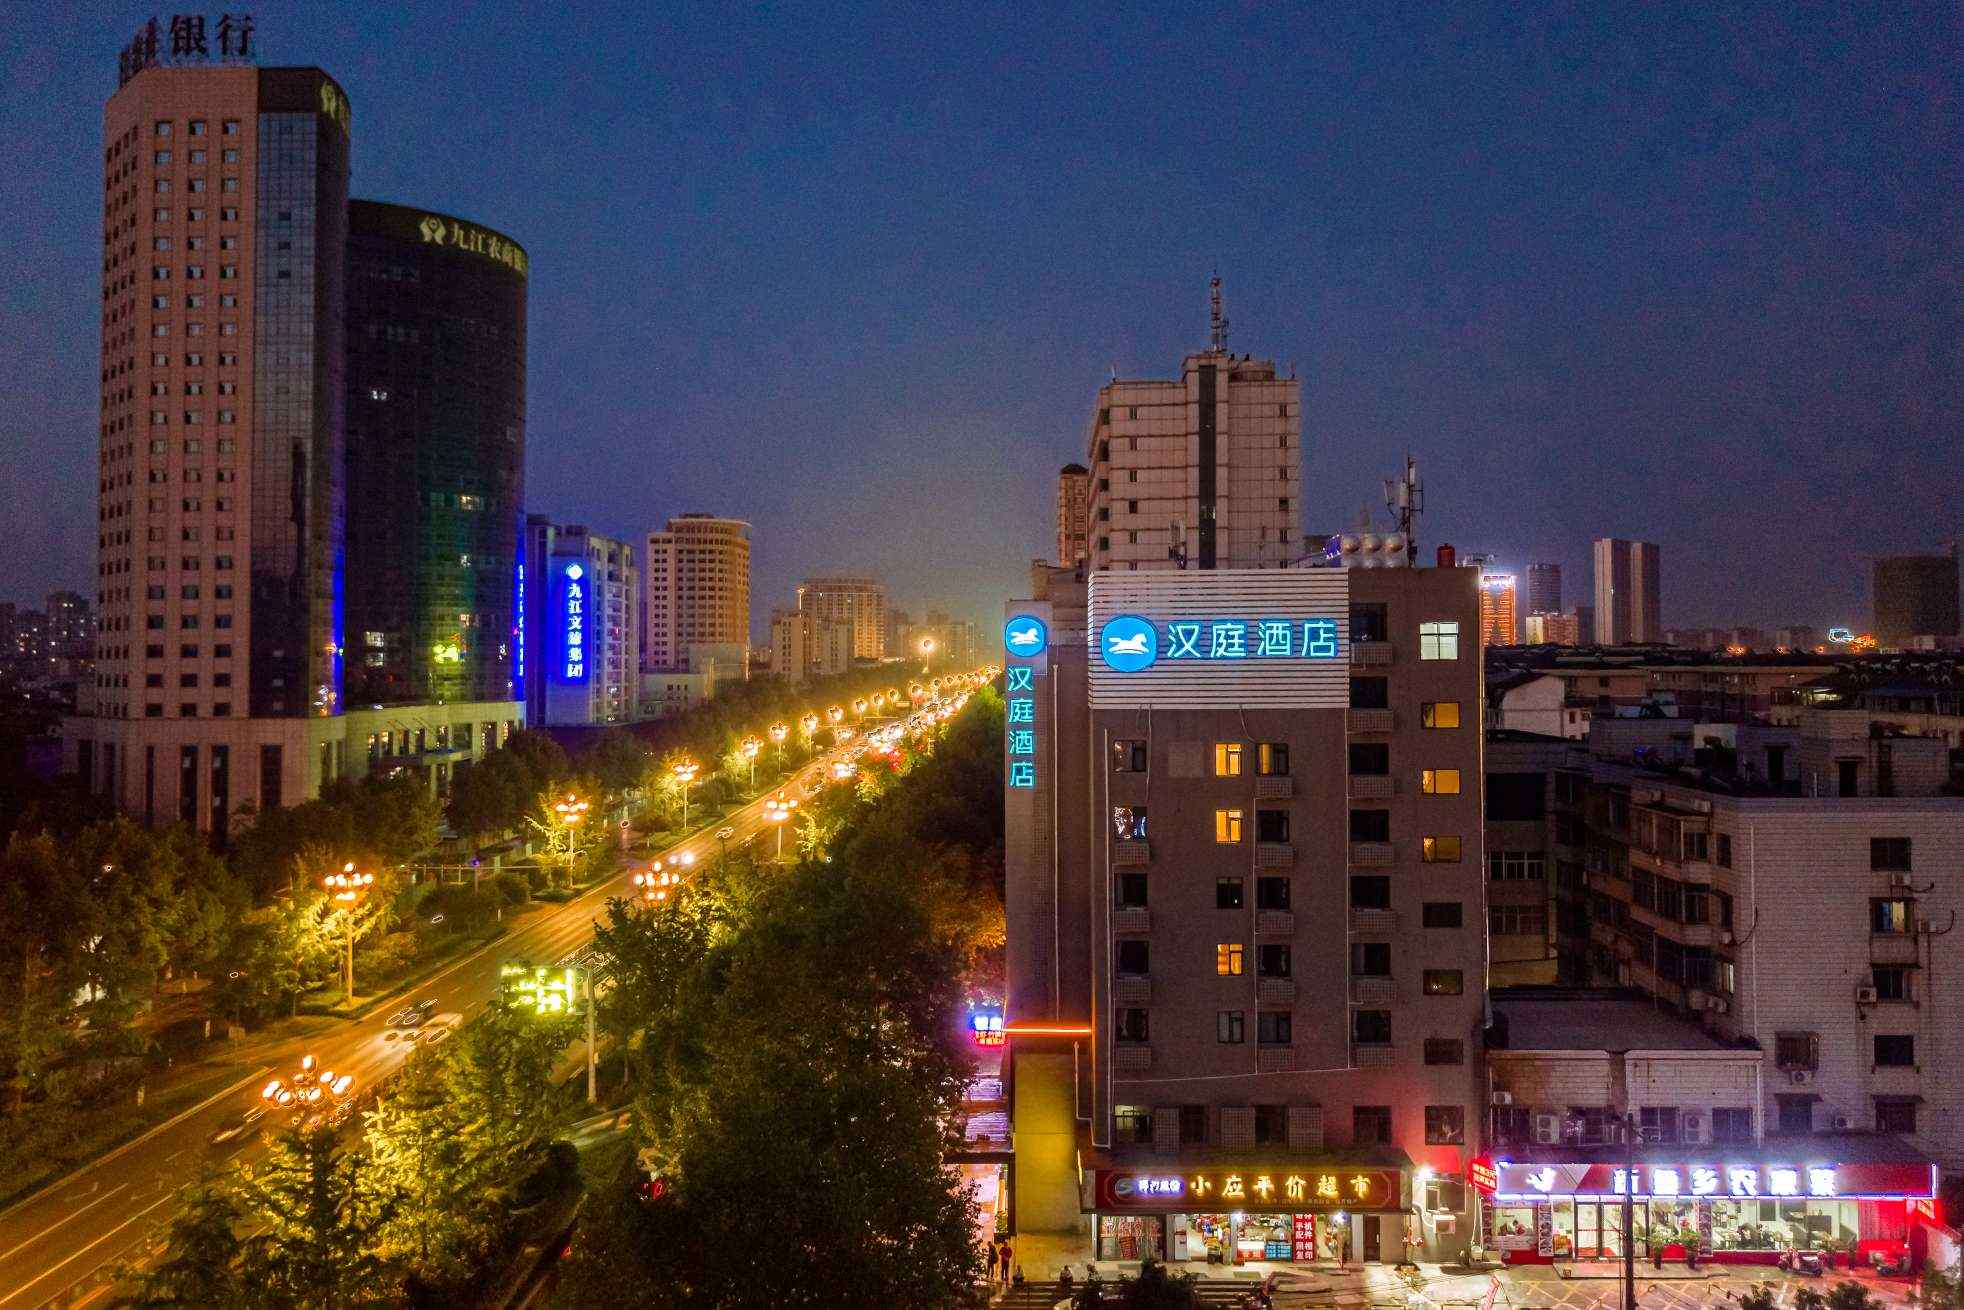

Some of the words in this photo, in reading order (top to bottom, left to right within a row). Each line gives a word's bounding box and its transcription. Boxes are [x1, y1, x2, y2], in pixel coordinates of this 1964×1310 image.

[1166, 621, 1338, 658] 汉庭酒店
[1008, 665, 1035, 788] 汉庭酒店
[1190, 1175, 1371, 1198] 小应平价超市
